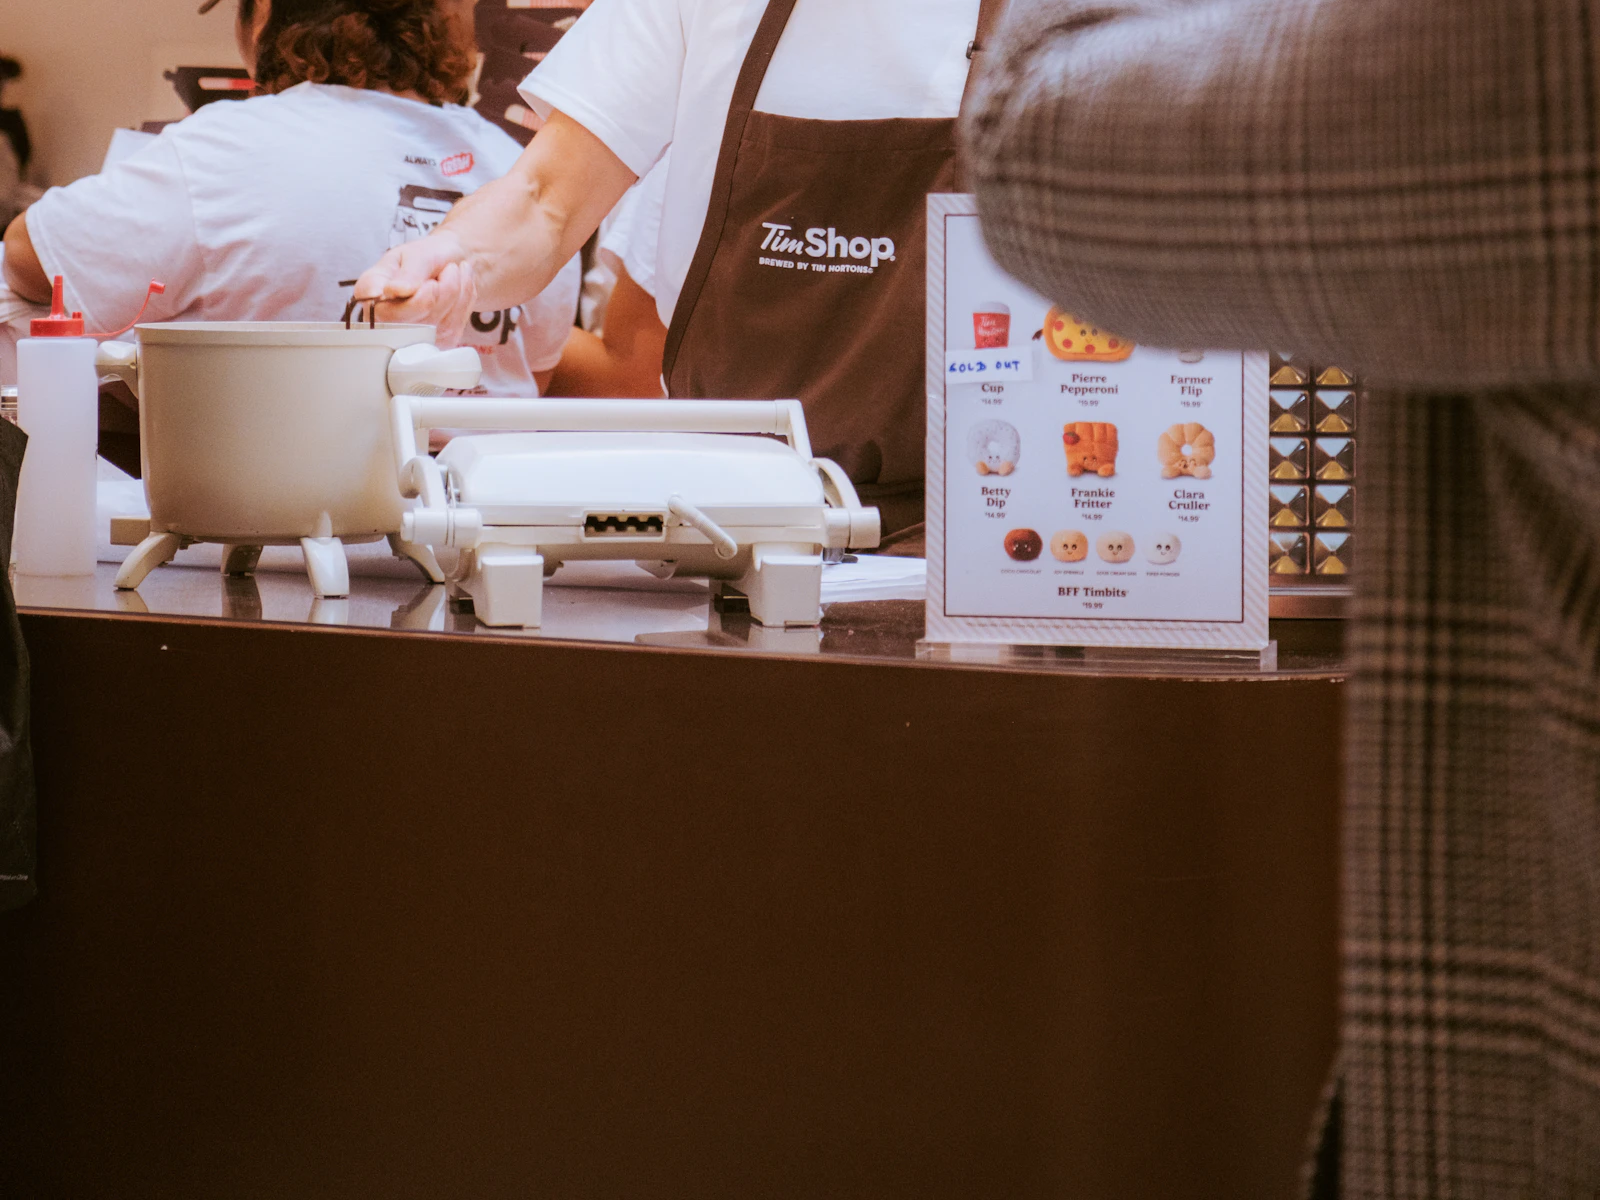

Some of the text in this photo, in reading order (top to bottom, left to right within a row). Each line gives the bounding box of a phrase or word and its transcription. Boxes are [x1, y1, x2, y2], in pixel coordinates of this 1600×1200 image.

[404, 155, 436, 166] ALWAYS
[760, 222, 896, 267] Tim Shop
[759, 257, 869, 274] BREWED BY TIM HORTONS
[995, 360, 1020, 371] OUT
[1072, 373, 1107, 383] Pierre
[1170, 375, 1213, 385] Farmer
[981, 383, 1004, 394] Cup
[1060, 384, 1119, 396] Pepperoni
[1181, 386, 1203, 397] Flip
[981, 486, 1011, 498] Betty
[1071, 488, 1116, 498] Frankie
[1173, 489, 1205, 500] Clara
[986, 498, 1006, 509] Dip
[1074, 499, 1112, 509] Fritter
[1168, 501, 1211, 511] Cruller
[1058, 587, 1127, 598] BFF Timbits
